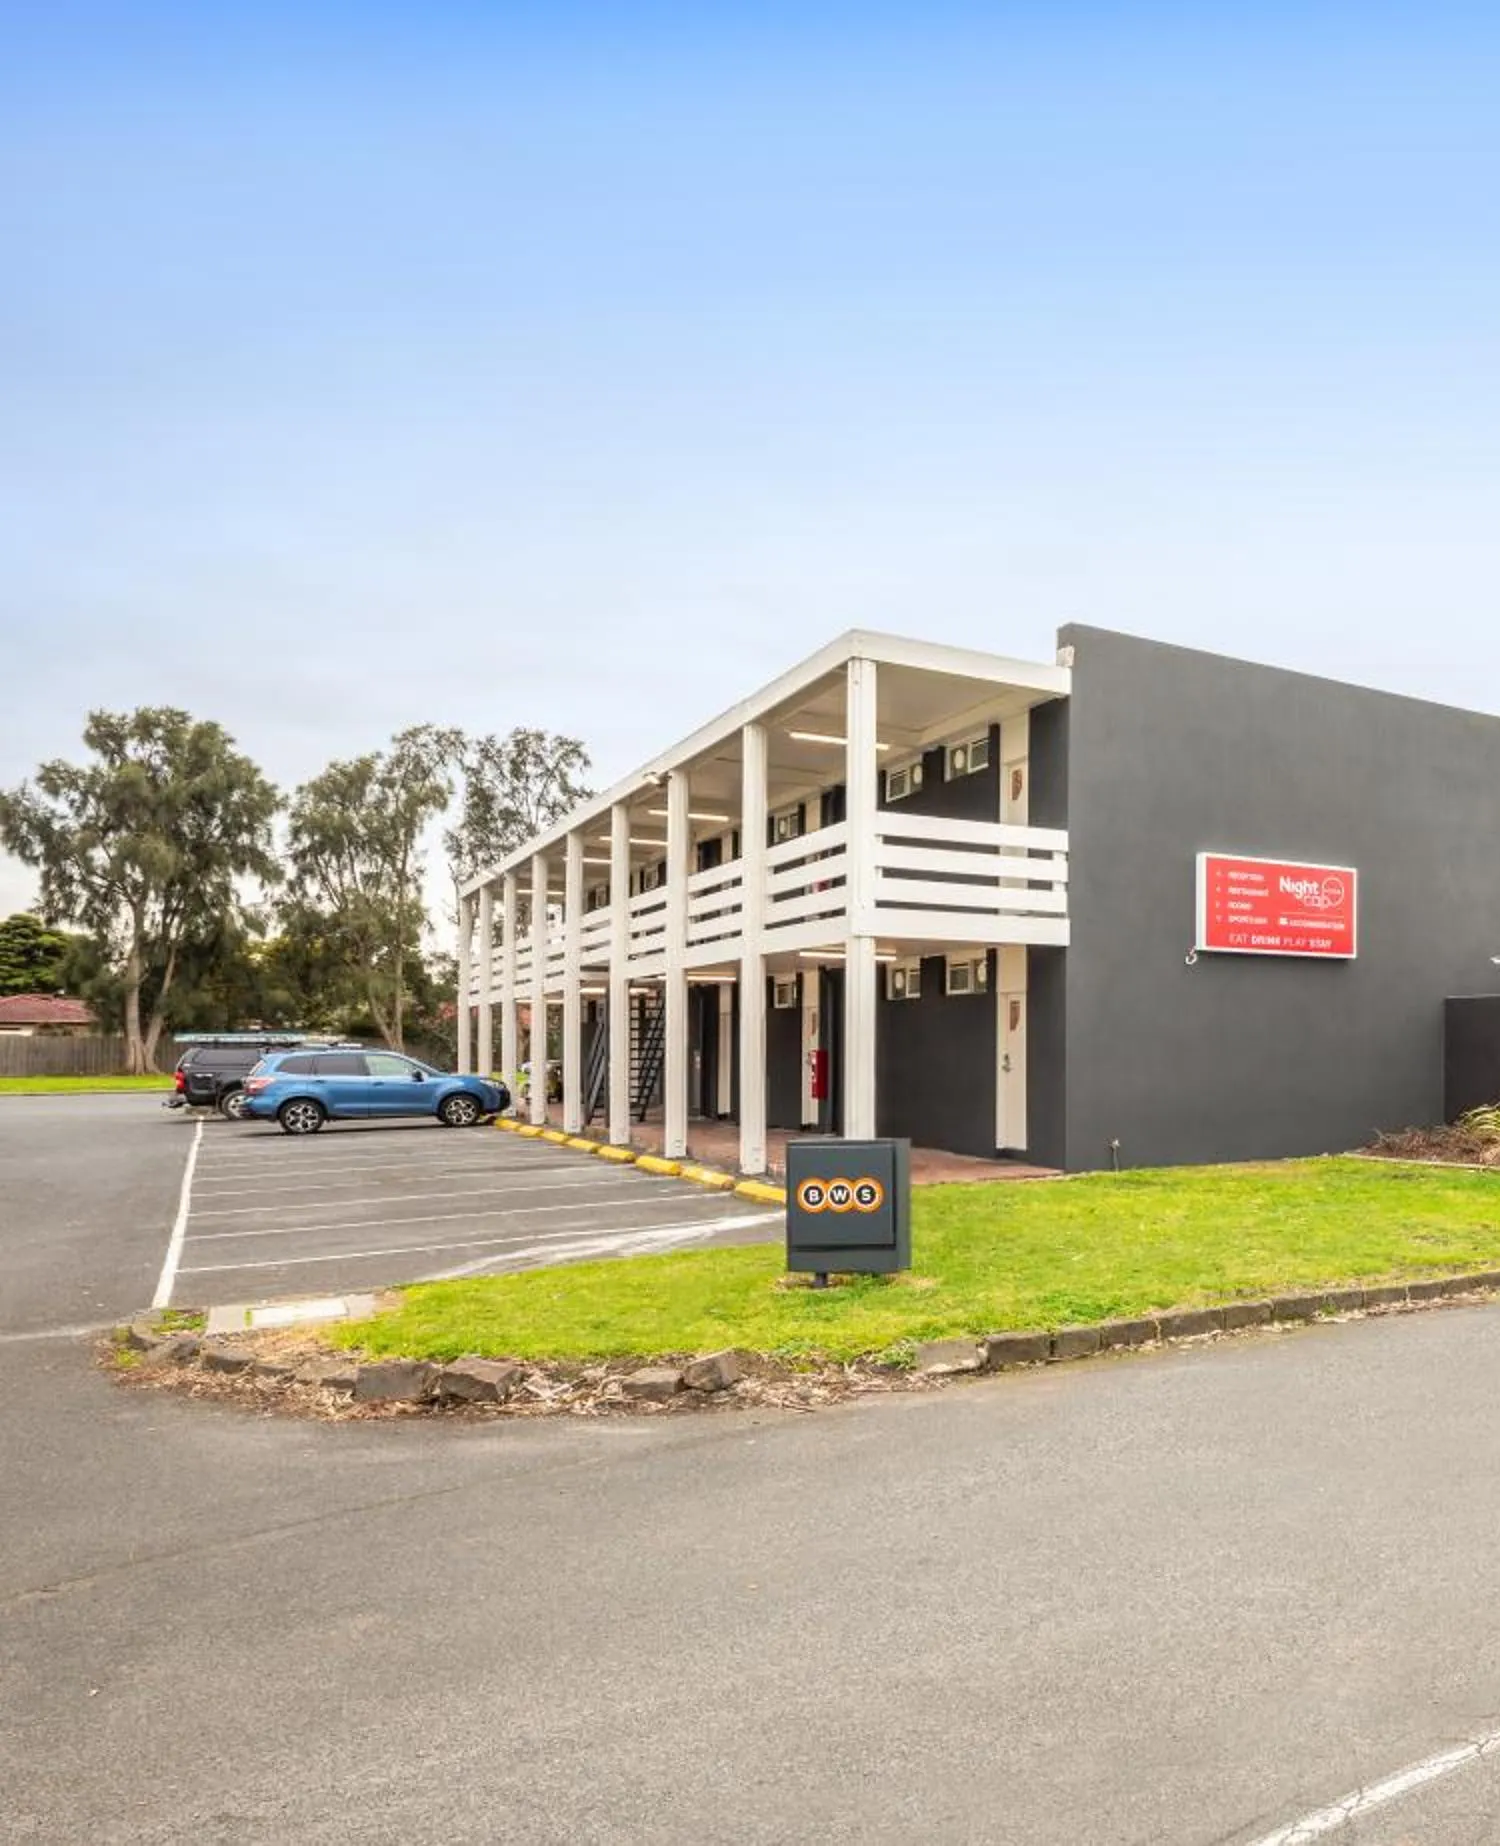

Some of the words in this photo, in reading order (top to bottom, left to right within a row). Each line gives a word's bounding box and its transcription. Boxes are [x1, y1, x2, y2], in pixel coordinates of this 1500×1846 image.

[1279, 876, 1320, 899] Night
[1229, 933, 1248, 945] EAT
[1251, 935, 1281, 946] DRINK
[1309, 938, 1332, 949] STAY
[809, 1189, 870, 1201] BWS
